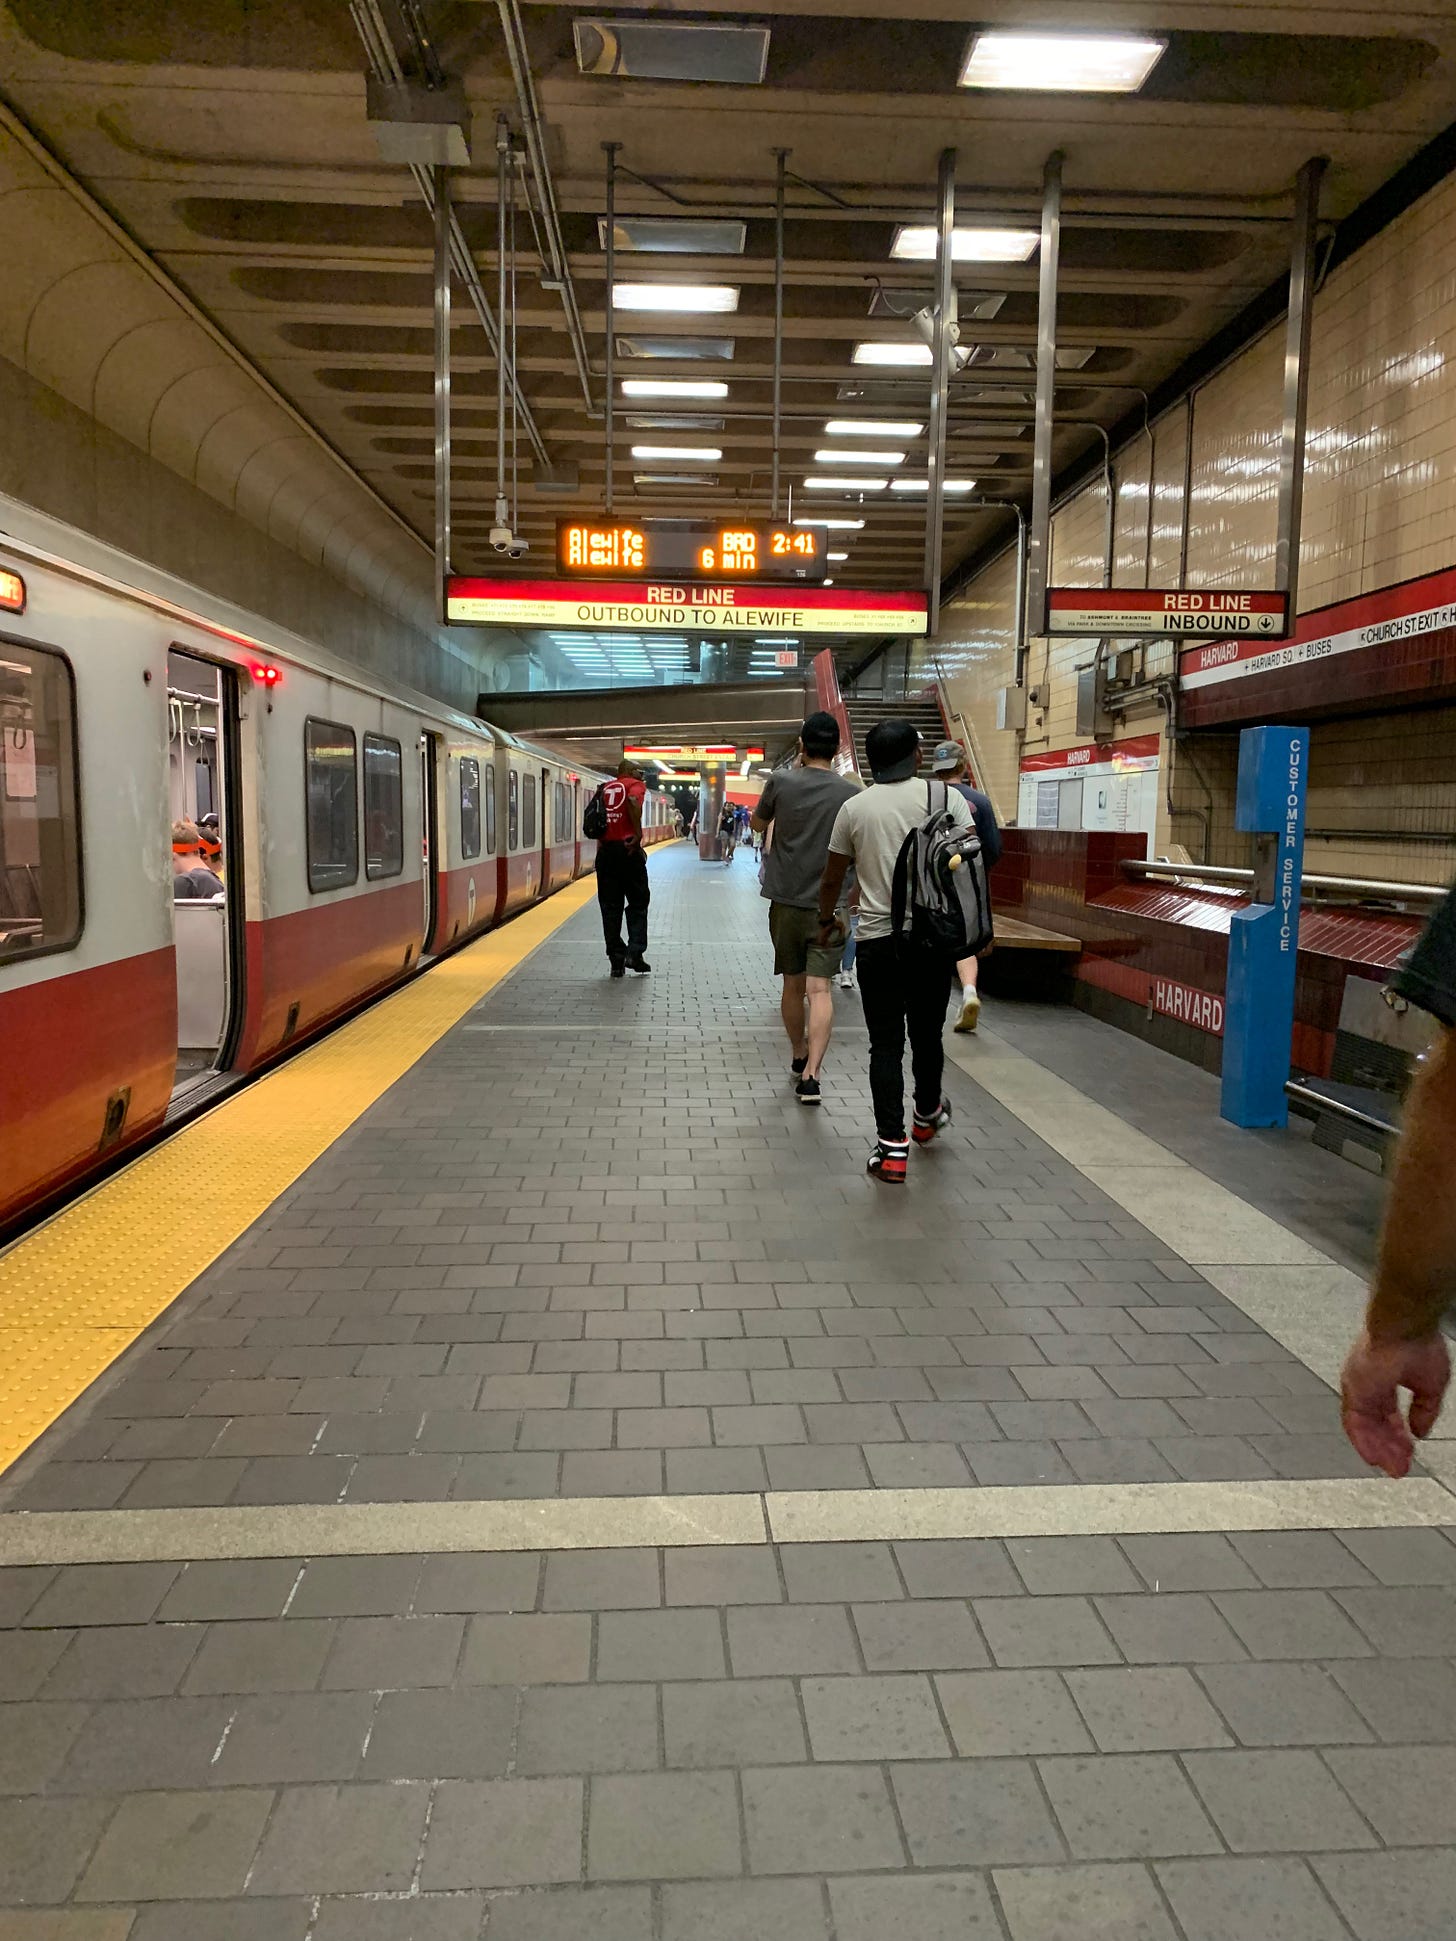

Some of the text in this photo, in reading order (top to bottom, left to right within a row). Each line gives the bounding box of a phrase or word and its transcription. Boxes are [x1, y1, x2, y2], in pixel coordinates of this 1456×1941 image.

[568, 528, 814, 554] Alewife BRD 2:41
[568, 546, 756, 569] Alewife 6 min
[647, 586, 735, 605] RED LINE
[1164, 594, 1252, 611] RED LINE
[577, 605, 804, 627] OUTBOUND TO ALEWIFE
[1163, 615, 1251, 631] INBOUND
[1366, 620, 1402, 643] CHURCH
[1201, 641, 1239, 668] HARVARD
[1306, 639, 1332, 658] BUSES
[1251, 653, 1281, 672] HARVARD
[1067, 750, 1090, 765] HARVARD
[604, 787, 622, 806] T
[1280, 739, 1301, 951] CUSTOMER SERVICE
[1156, 980, 1223, 1031] HARVARD
